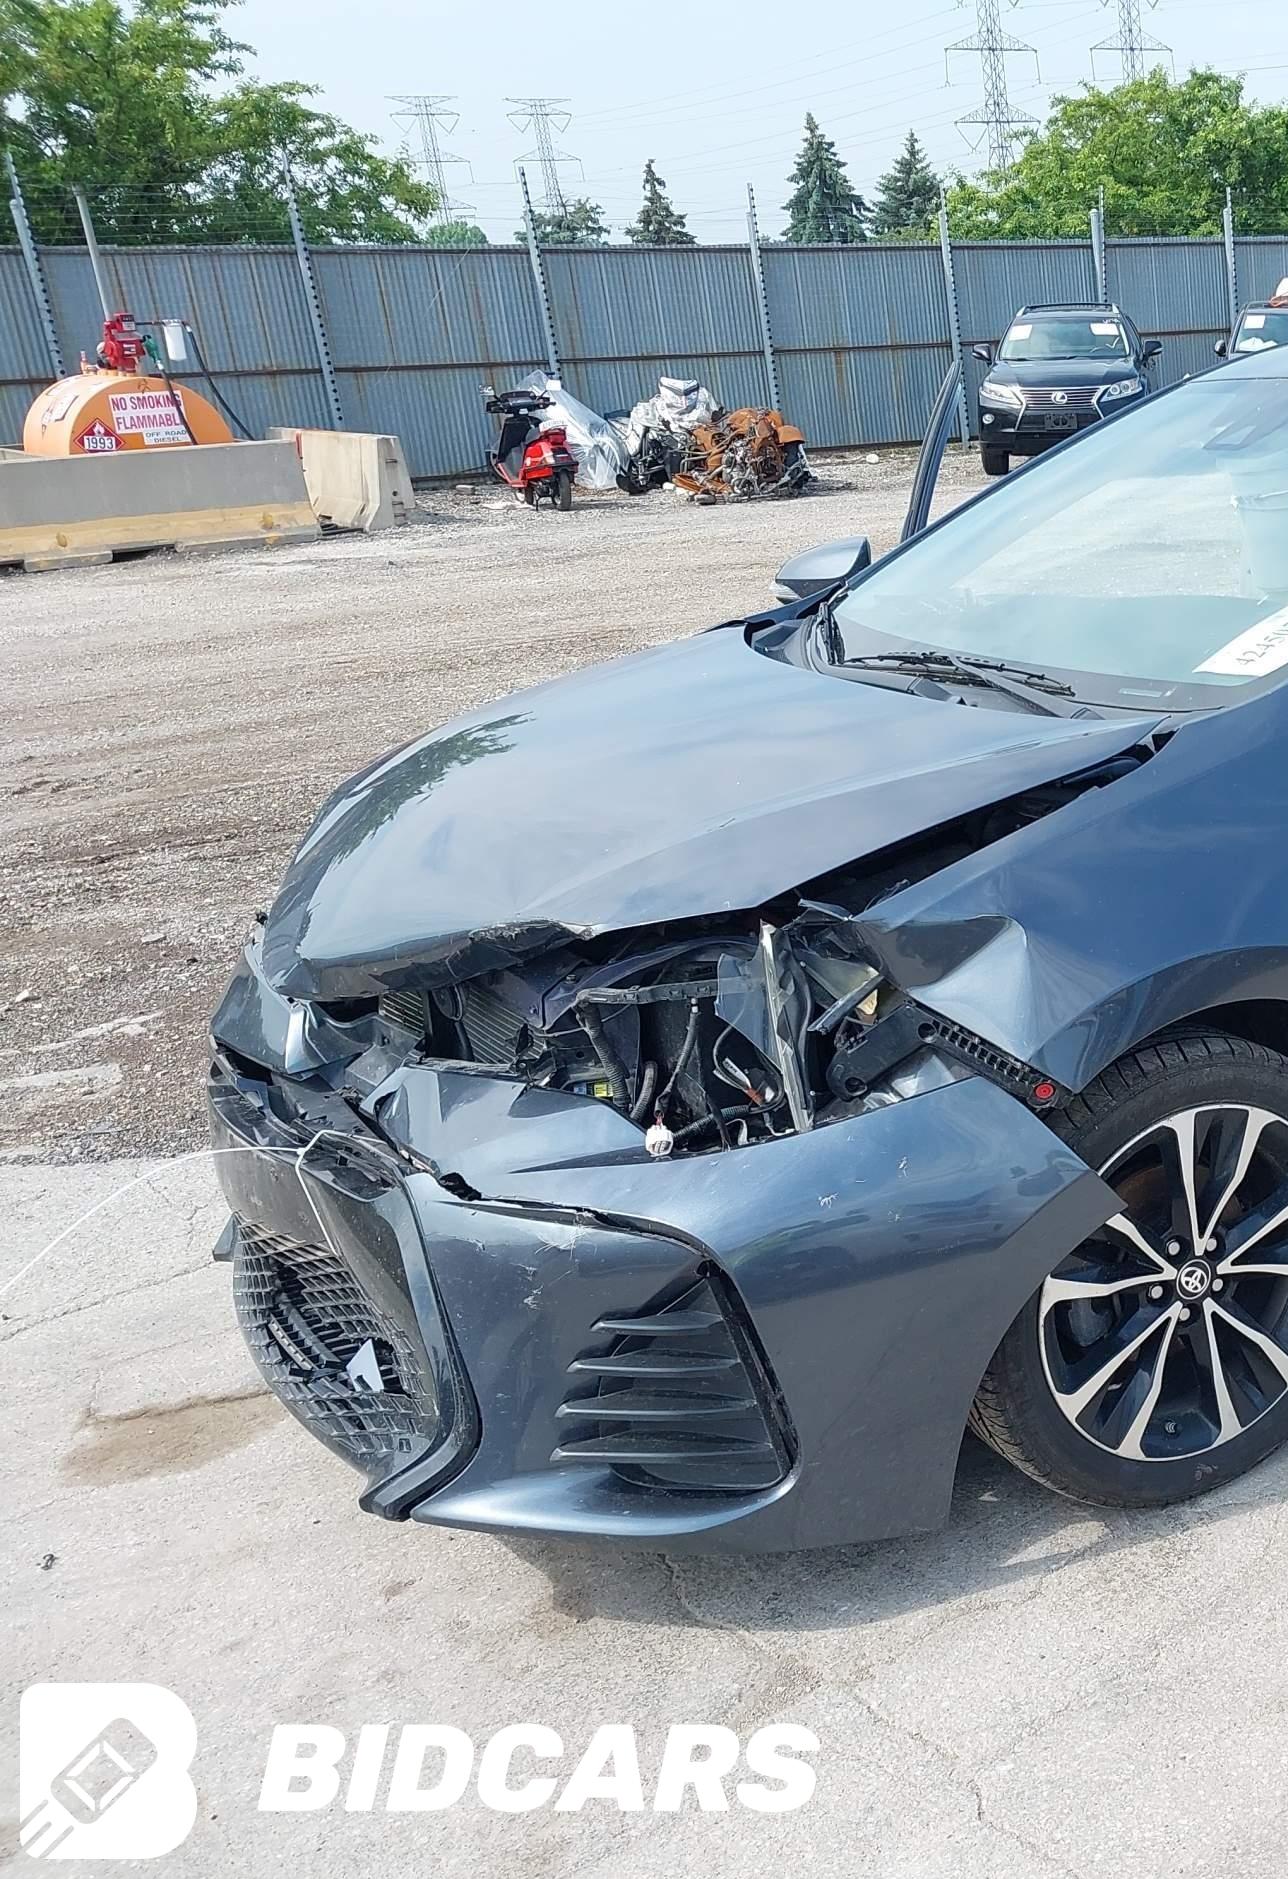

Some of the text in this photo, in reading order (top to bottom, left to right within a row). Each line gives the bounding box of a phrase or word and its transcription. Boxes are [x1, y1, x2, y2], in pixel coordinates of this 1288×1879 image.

[111, 397, 128, 411] NO
[115, 412, 182, 430] FLAMMABL
[145, 429, 187, 438] OFF ROAD
[153, 435, 181, 443] DIESEL
[86, 436, 114, 450] 1993
